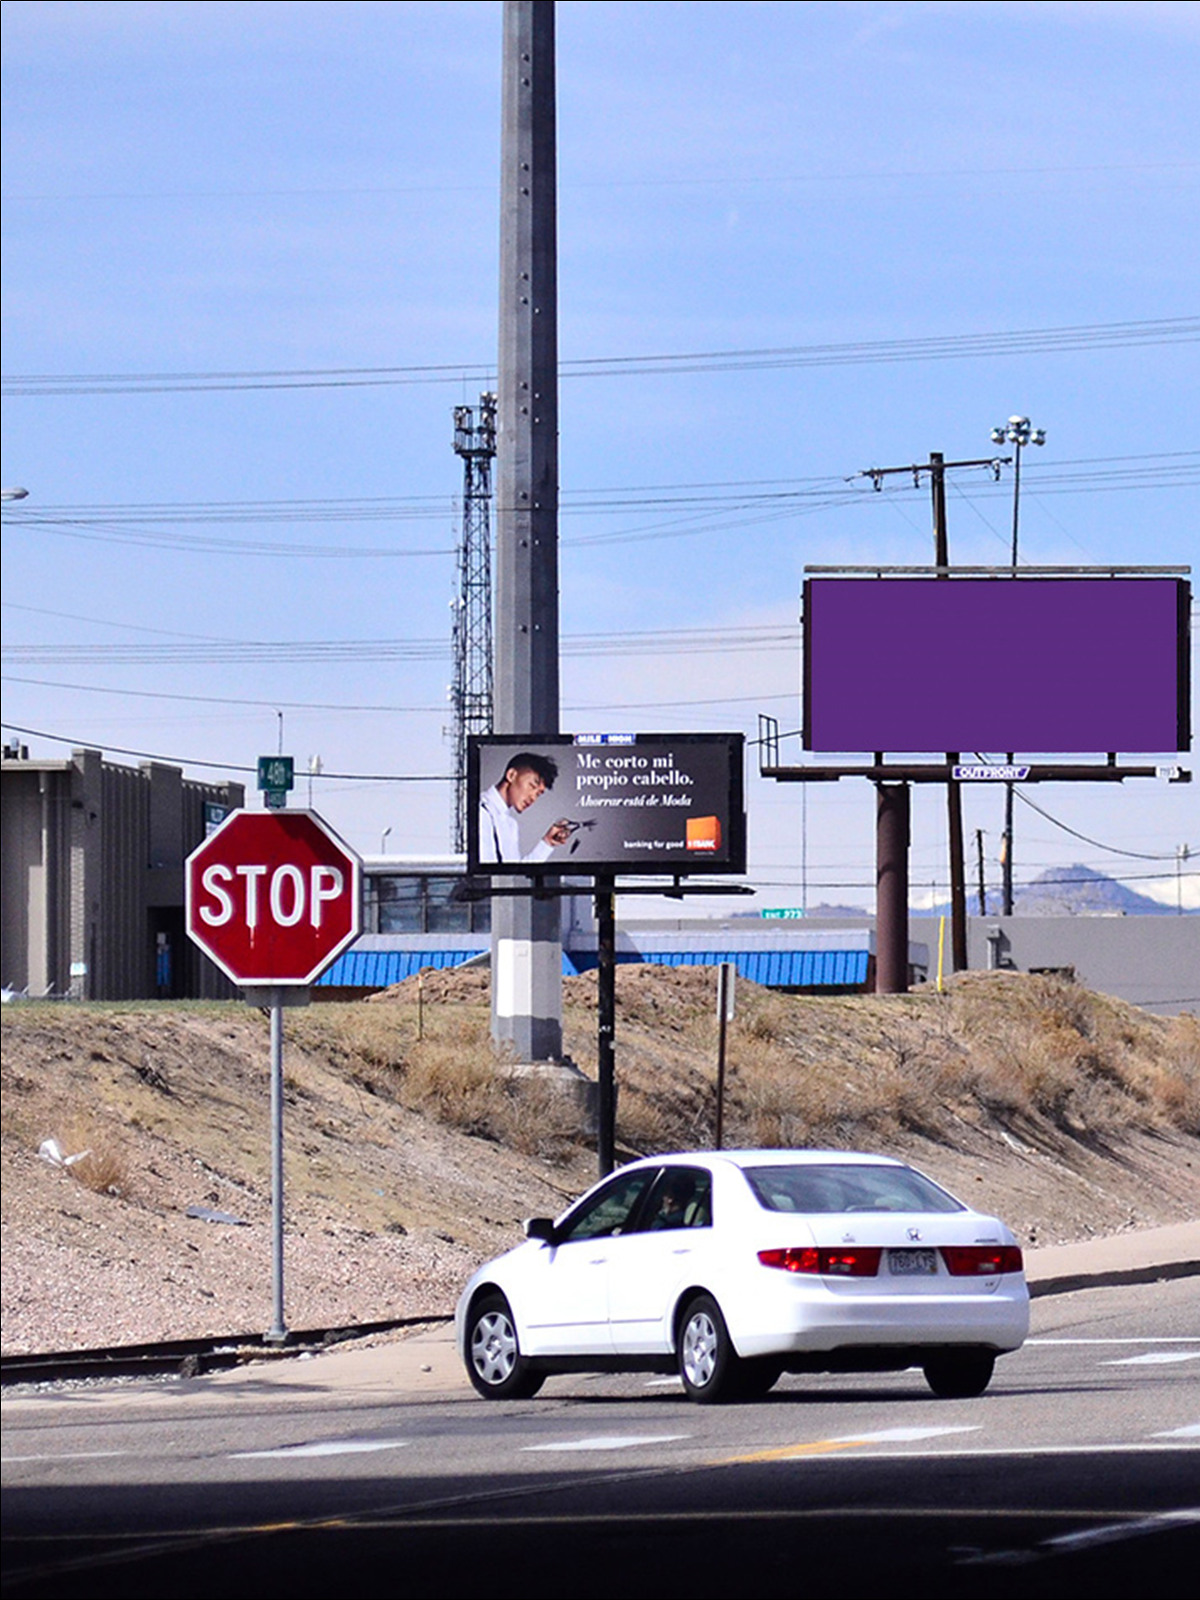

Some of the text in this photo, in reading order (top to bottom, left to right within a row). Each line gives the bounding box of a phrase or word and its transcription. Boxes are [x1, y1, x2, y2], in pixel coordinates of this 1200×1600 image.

[577, 753, 673, 768] Me corto mi
[960, 766, 1019, 778] OUTFRONT
[576, 770, 694, 790] propio cabello.
[576, 794, 692, 807] Ahorrar está de Moda
[623, 840, 684, 850] banking for good
[199, 864, 344, 927] STOP
